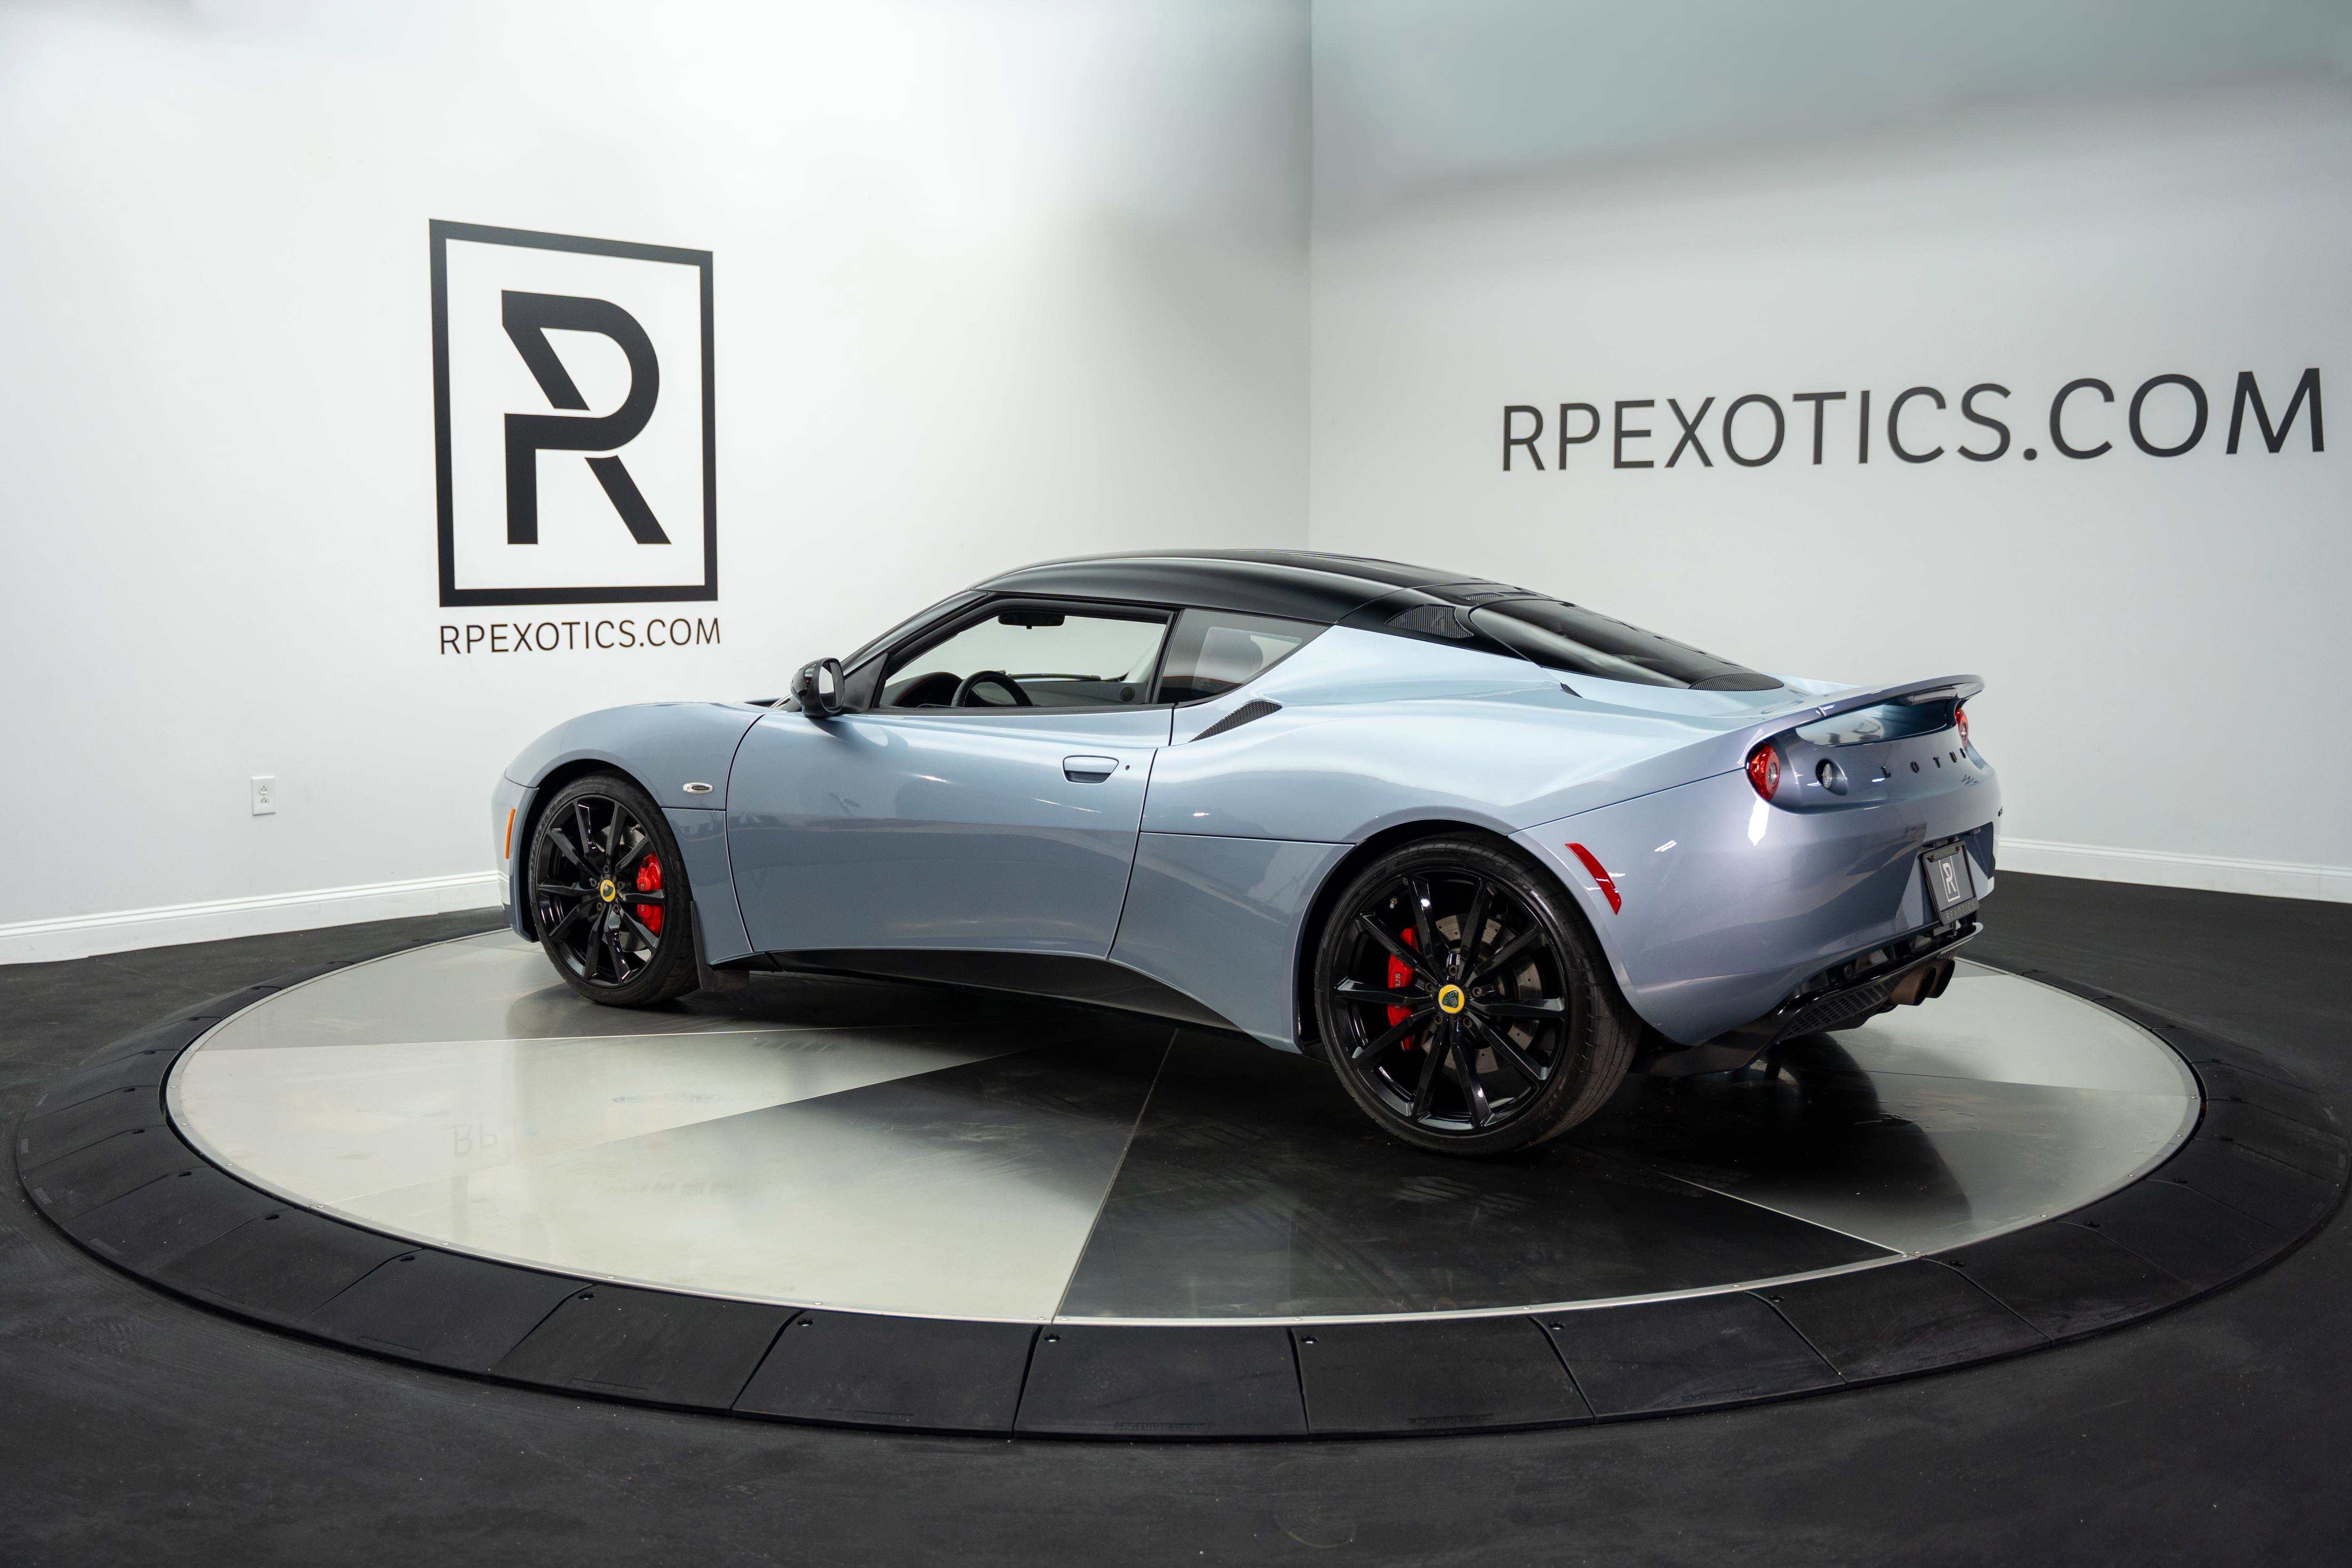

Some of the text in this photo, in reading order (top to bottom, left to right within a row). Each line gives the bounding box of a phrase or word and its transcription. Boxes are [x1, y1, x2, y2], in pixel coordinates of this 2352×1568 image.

[1502, 367, 2325, 471] RPEXOTICS.COM
[440, 617, 721, 654] RPEXOTICS.COM
[1880, 747, 1967, 779] LOTUS
